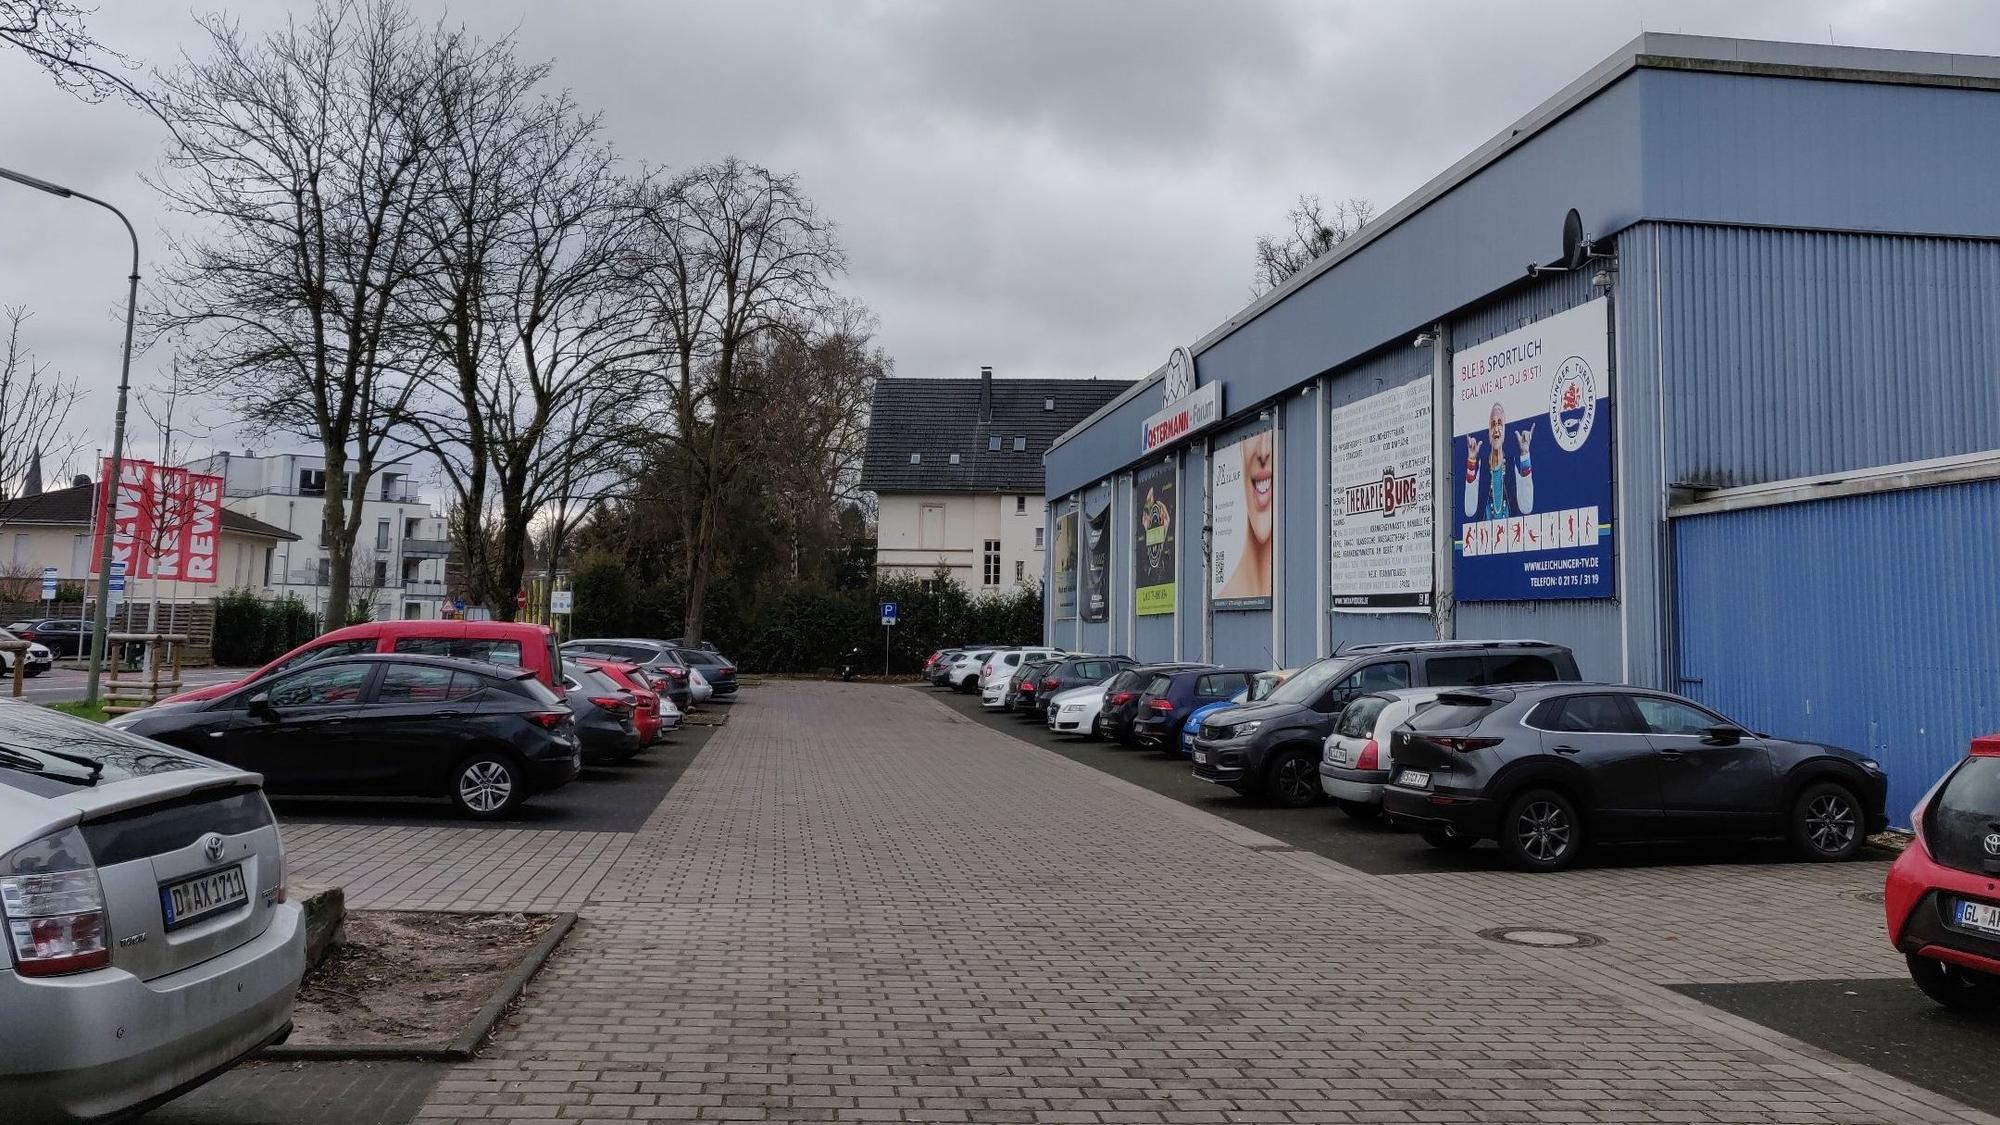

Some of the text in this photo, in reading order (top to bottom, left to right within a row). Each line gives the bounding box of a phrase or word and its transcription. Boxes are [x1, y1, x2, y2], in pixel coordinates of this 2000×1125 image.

[1461, 338, 1542, 381] BLEIB SPORTLICH
[1462, 364, 1542, 400] EGAL WIE ALT DU BIST!
[1576, 363, 1594, 432] TURNVEREIN
[1148, 410, 1189, 448] OSTERMANN
[1346, 477, 1416, 513] THERAPIEBURG
[112, 465, 146, 573] REWE
[147, 472, 180, 576] REWE
[187, 481, 218, 578] REWE
[1524, 558, 1598, 572] WWW.LEICHLINGER-TV.DE
[1530, 576, 1557, 587] TELEFON:
[1558, 576, 1562, 586] 0
[1571, 575, 1578, 584] 75
[885, 605, 893, 615] P
[173, 888, 184, 916] D
[1965, 904, 1978, 922] GL
